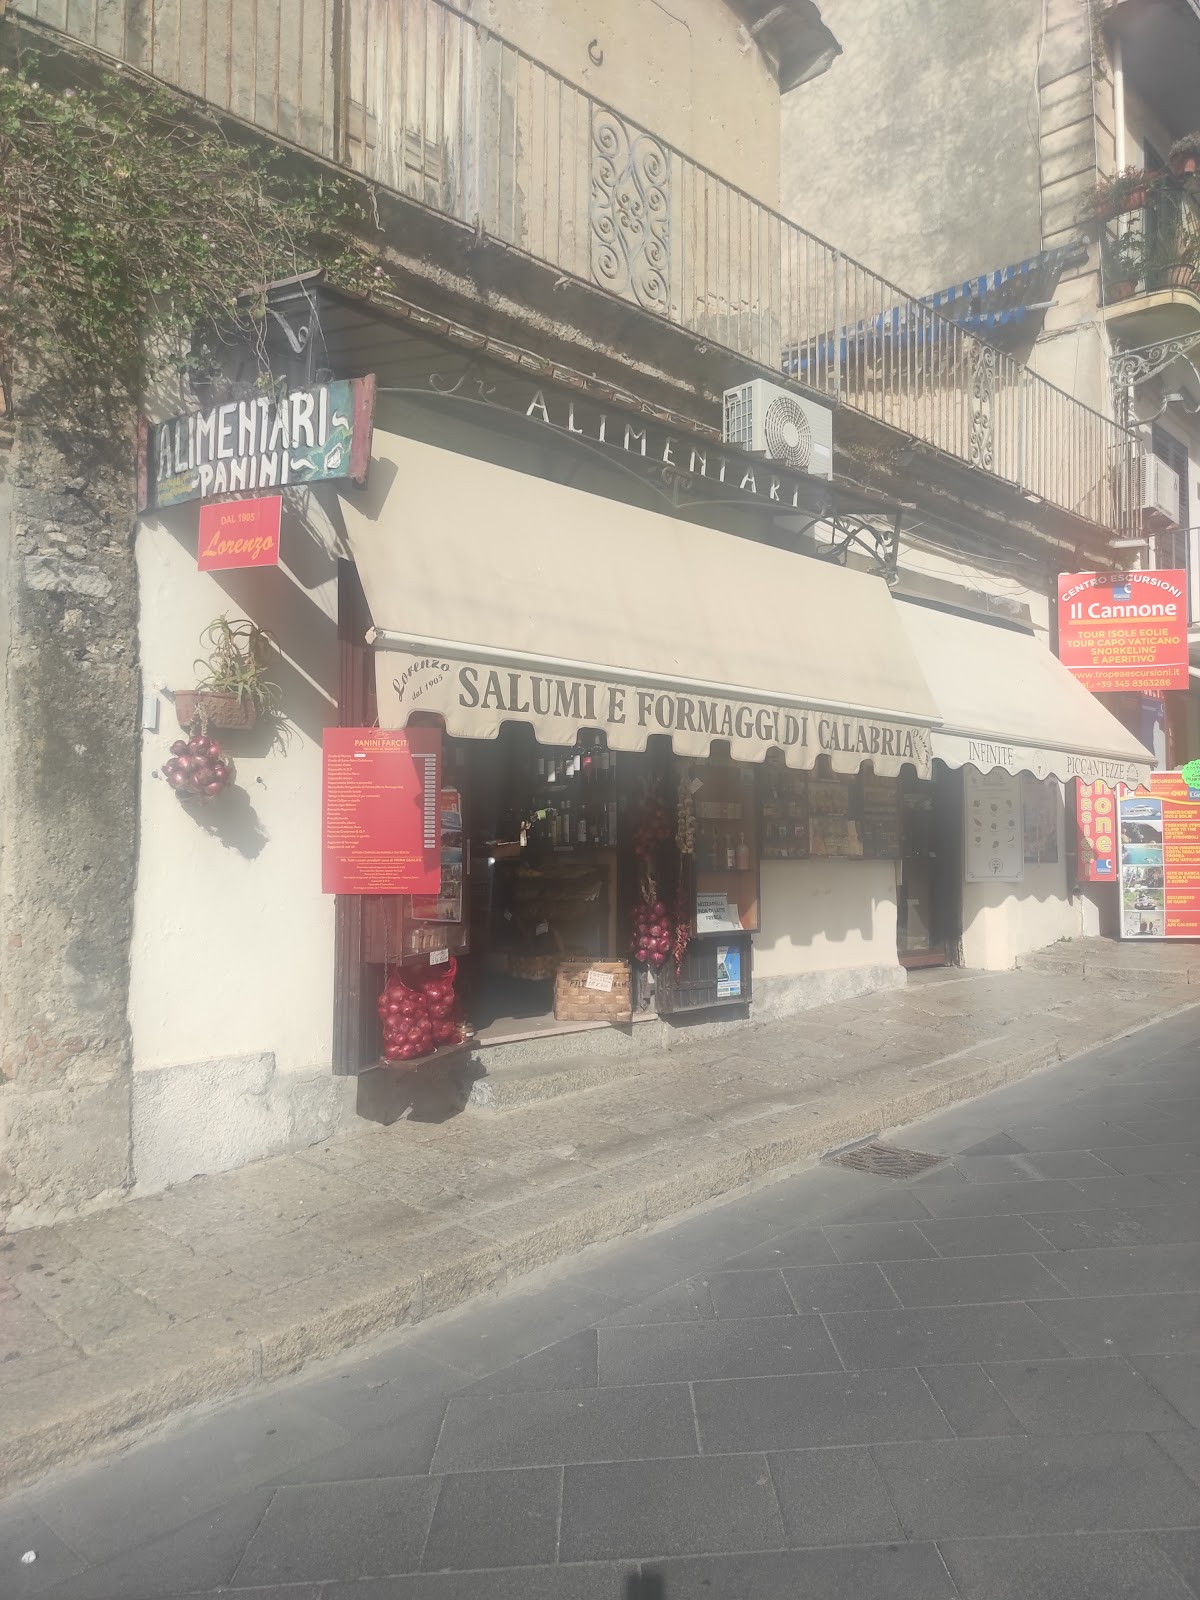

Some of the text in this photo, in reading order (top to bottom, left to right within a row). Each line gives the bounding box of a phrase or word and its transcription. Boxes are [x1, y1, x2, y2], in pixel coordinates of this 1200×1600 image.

[157, 387, 327, 481] ALIMENTARI
[525, 389, 799, 507] ALIMENTARI
[198, 450, 290, 497] PANINI
[220, 512, 256, 524] DAL 1905
[202, 530, 274, 561] Lorenzo
[1061, 574, 1182, 602] CENTRO ESCURSIONI
[1070, 603, 1177, 620] Il Cannone
[1067, 637, 1180, 648] TOUR CAPO VATICANO
[1078, 628, 1169, 639] TOUR ISOLE EOLIE
[1090, 646, 1157, 656] SNORKELING
[1092, 655, 1155, 664] E APERITIVO
[392, 659, 451, 702] Lorenzo
[411, 674, 444, 701] dal 1905
[1096, 680, 1112, 688] +39
[1114, 680, 1130, 688] 345
[1132, 679, 1171, 687] 8363286
[458, 666, 597, 720] SALUMI
[606, 687, 626, 724] E
[636, 691, 780, 743] FORMAGGI
[783, 714, 809, 747] DI
[818, 719, 914, 758] CALABRIA
[968, 741, 1014, 766] INFINITE
[1067, 756, 1126, 781] PICCANTEZZE
[1080, 780, 1094, 876] URSIONI
